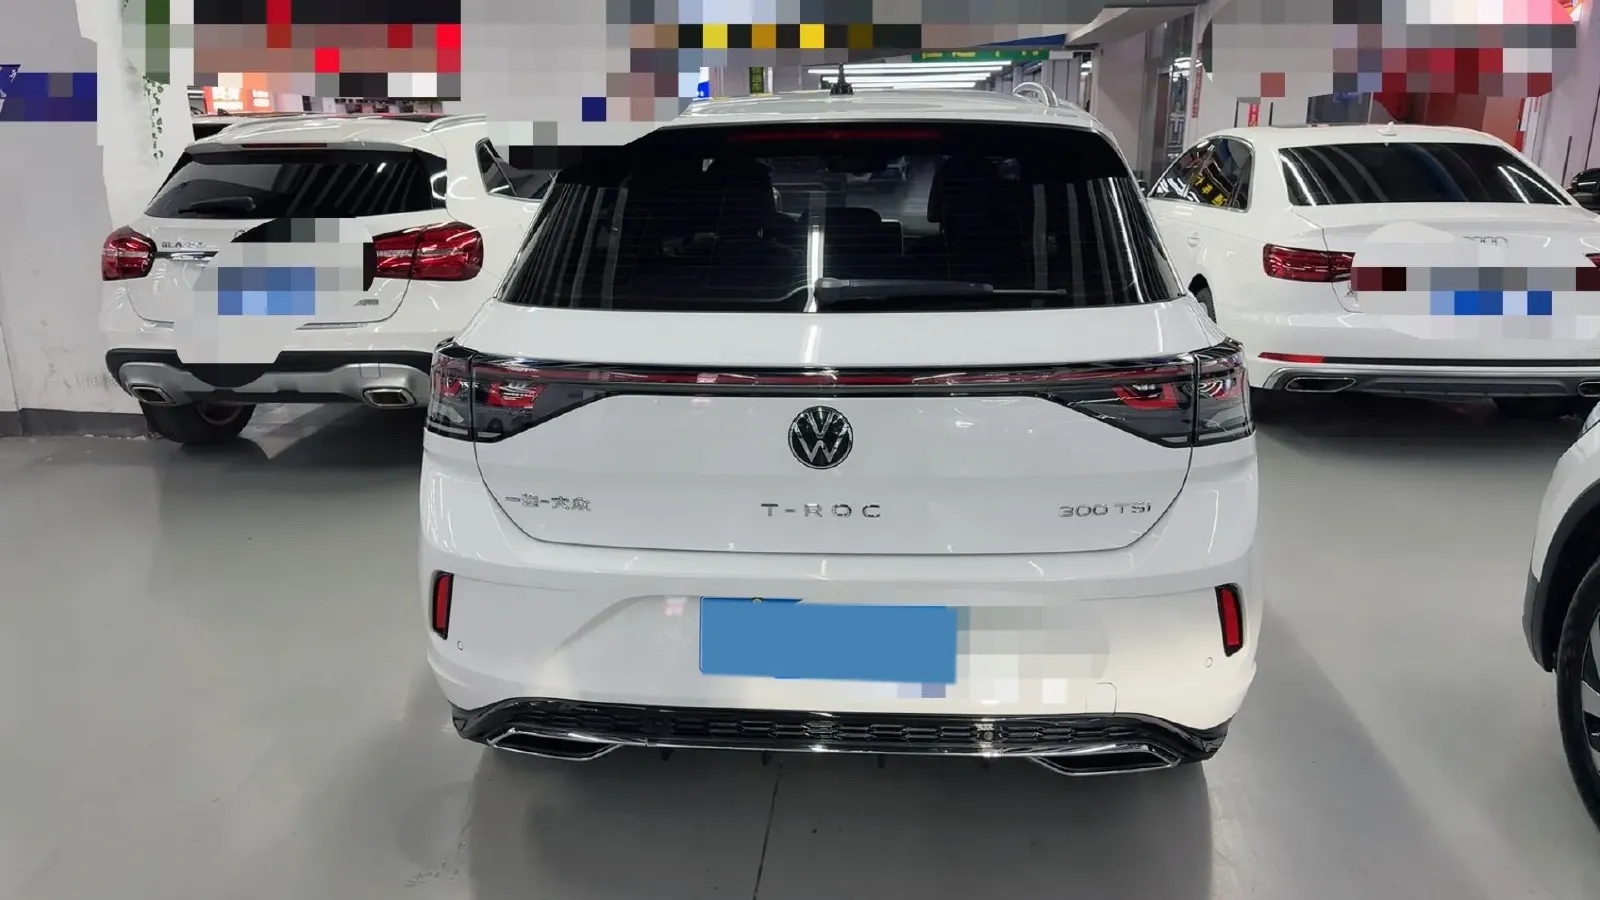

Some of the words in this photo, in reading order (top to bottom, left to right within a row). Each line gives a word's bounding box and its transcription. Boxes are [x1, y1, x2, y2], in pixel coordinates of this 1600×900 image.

[792, 410, 849, 463] VW
[760, 503, 881, 518] T-ROC
[1059, 504, 1108, 518] 300
